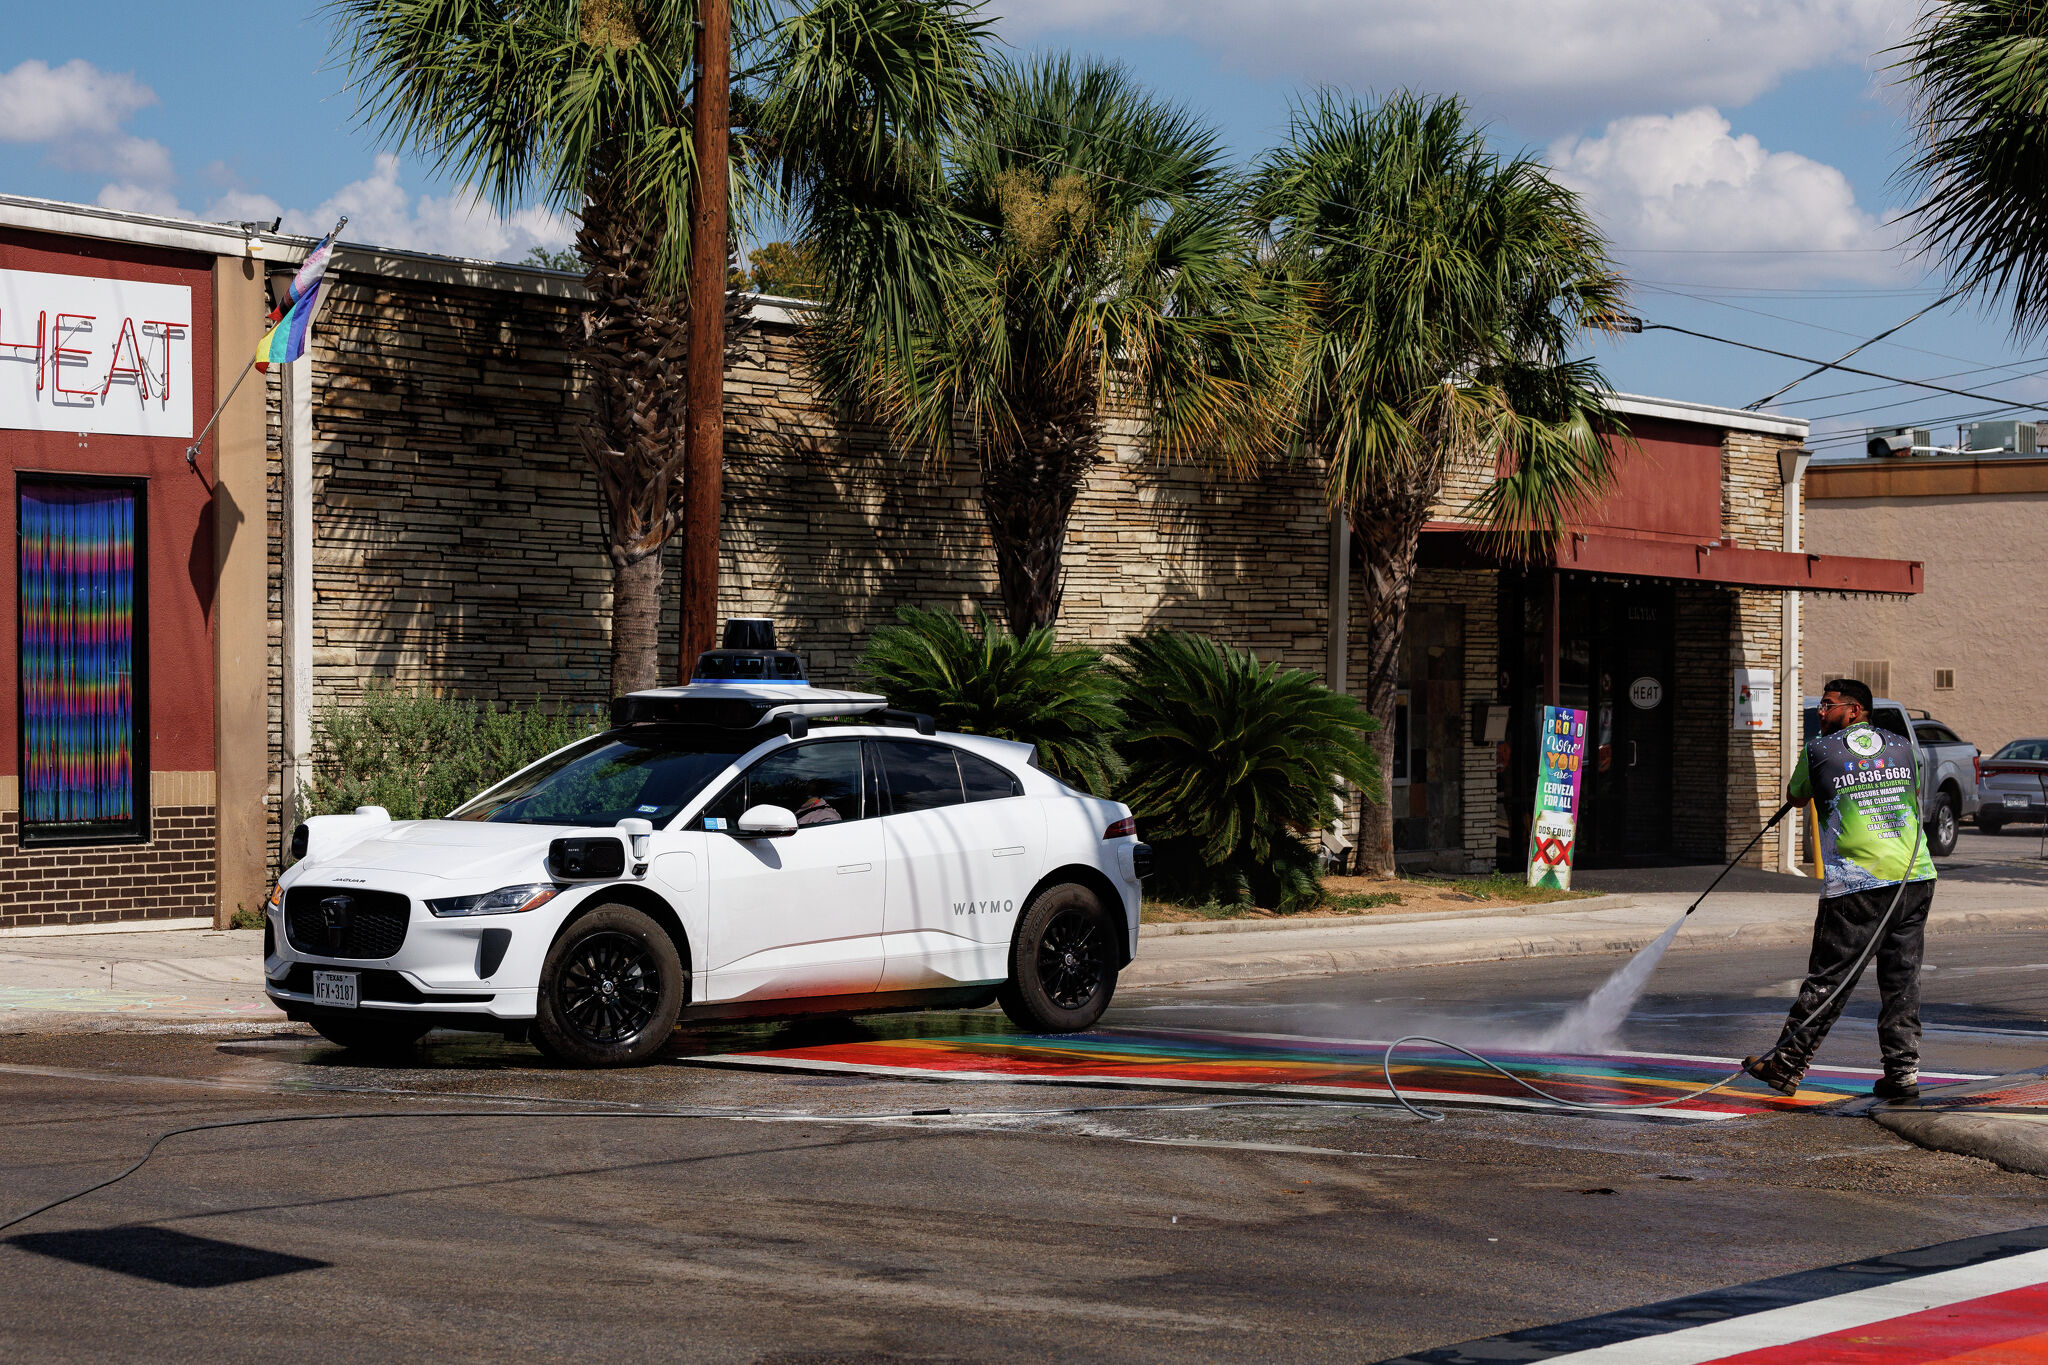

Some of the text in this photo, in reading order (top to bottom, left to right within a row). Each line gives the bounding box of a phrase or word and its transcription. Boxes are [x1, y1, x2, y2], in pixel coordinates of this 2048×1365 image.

[0, 309, 189, 400] HEAT
[1633, 686, 1659, 700] HEAT
[1559, 710, 1573, 720] be
[1547, 719, 1583, 737] PROUD
[1546, 751, 1579, 772] YOU
[1548, 769, 1572, 779] are
[1833, 767, 1911, 789] 210-836-6682
[1544, 782, 1574, 796] CERVEZA
[1837, 784, 1874, 795] COMMERCIAL
[1880, 779, 1910, 788] RESIDENTIAL
[1850, 786, 1906, 800] PRESSURE WASHING
[1543, 794, 1571, 809] FOR ALL
[1858, 795, 1900, 807] ROOF CLEANING
[1858, 804, 1906, 816] WINDOW CLEANING
[1871, 812, 1896, 822] STRIPING
[1538, 825, 1572, 838] DOS EQUIS
[1867, 820, 1905, 831] SEAL COATING
[1883, 830, 1901, 839] MORE!
[1532, 836, 1574, 866] XX
[953, 899, 1013, 916] WAYMO
[326, 974, 343, 982] TEXAS
